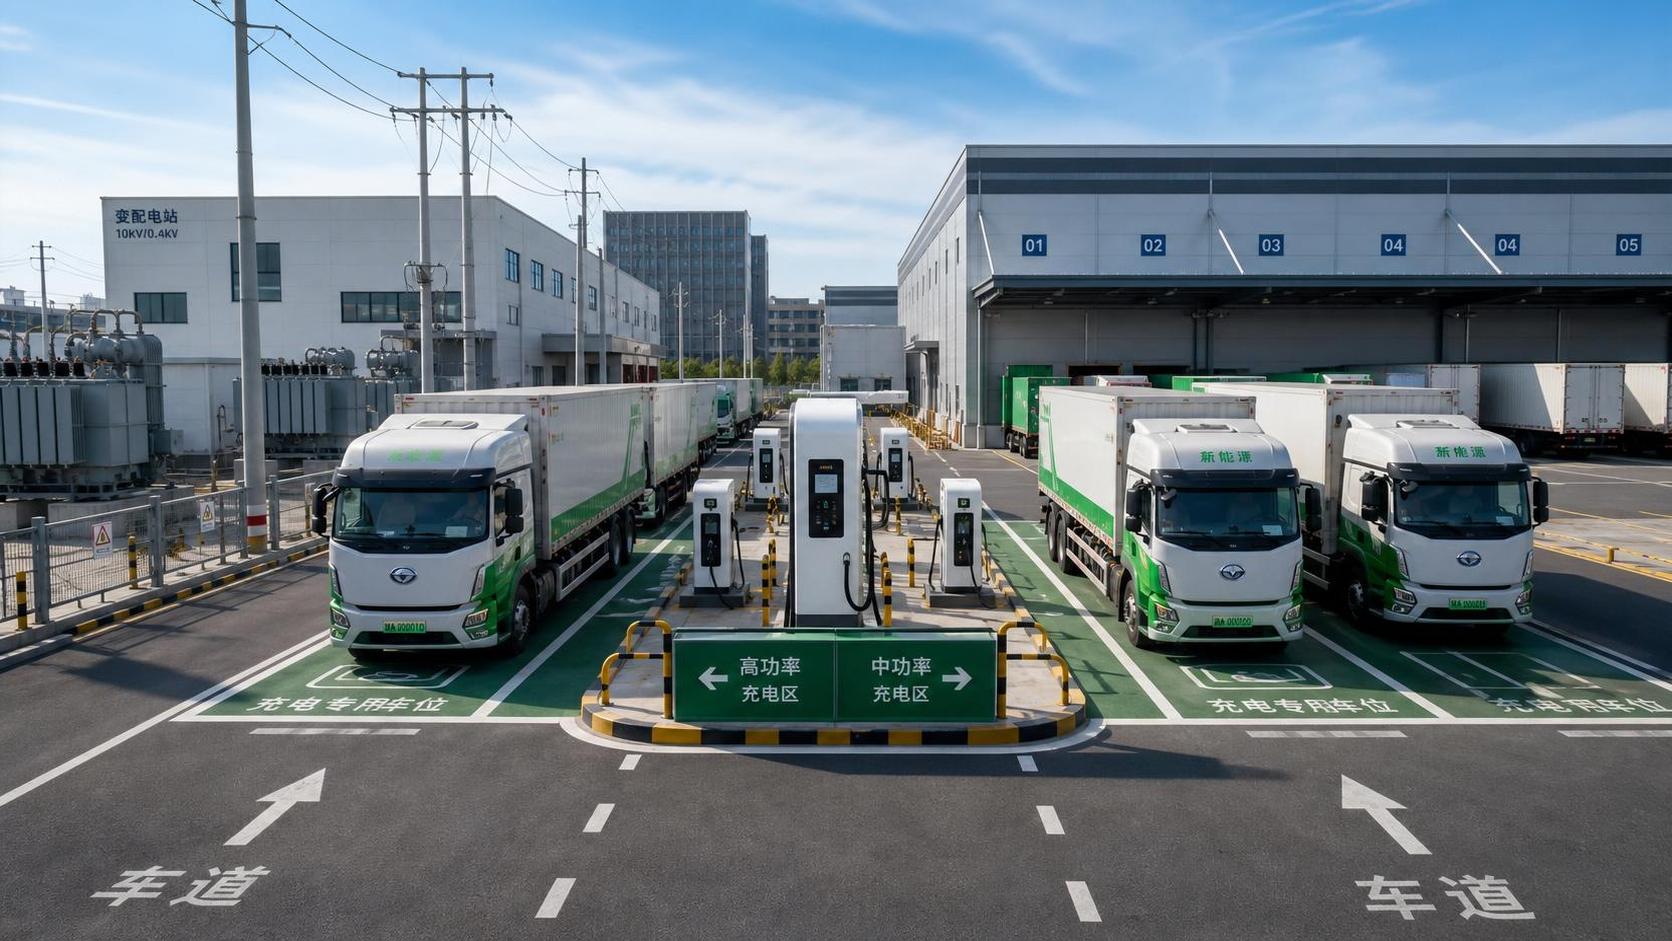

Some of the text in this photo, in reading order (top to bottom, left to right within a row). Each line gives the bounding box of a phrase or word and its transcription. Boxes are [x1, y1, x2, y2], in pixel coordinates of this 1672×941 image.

[115, 208, 178, 225] 变配电站
[1026, 239, 1042, 252] 01
[1144, 239, 1162, 252] 02
[1262, 239, 1280, 252] 03
[1384, 239, 1402, 252] 04
[1498, 239, 1516, 251] 04
[1620, 239, 1638, 251] 05
[1200, 450, 1257, 464] 新能源
[740, 656, 801, 676] 高功率
[872, 656, 931, 676] 中功率
[742, 685, 799, 703] 充电区
[873, 685, 929, 703] 充电区
[246, 697, 449, 712] 充电专用车位
[1207, 697, 1398, 714] 充电专用车位
[90, 865, 271, 907] 车道
[1354, 874, 1536, 920] 车道
